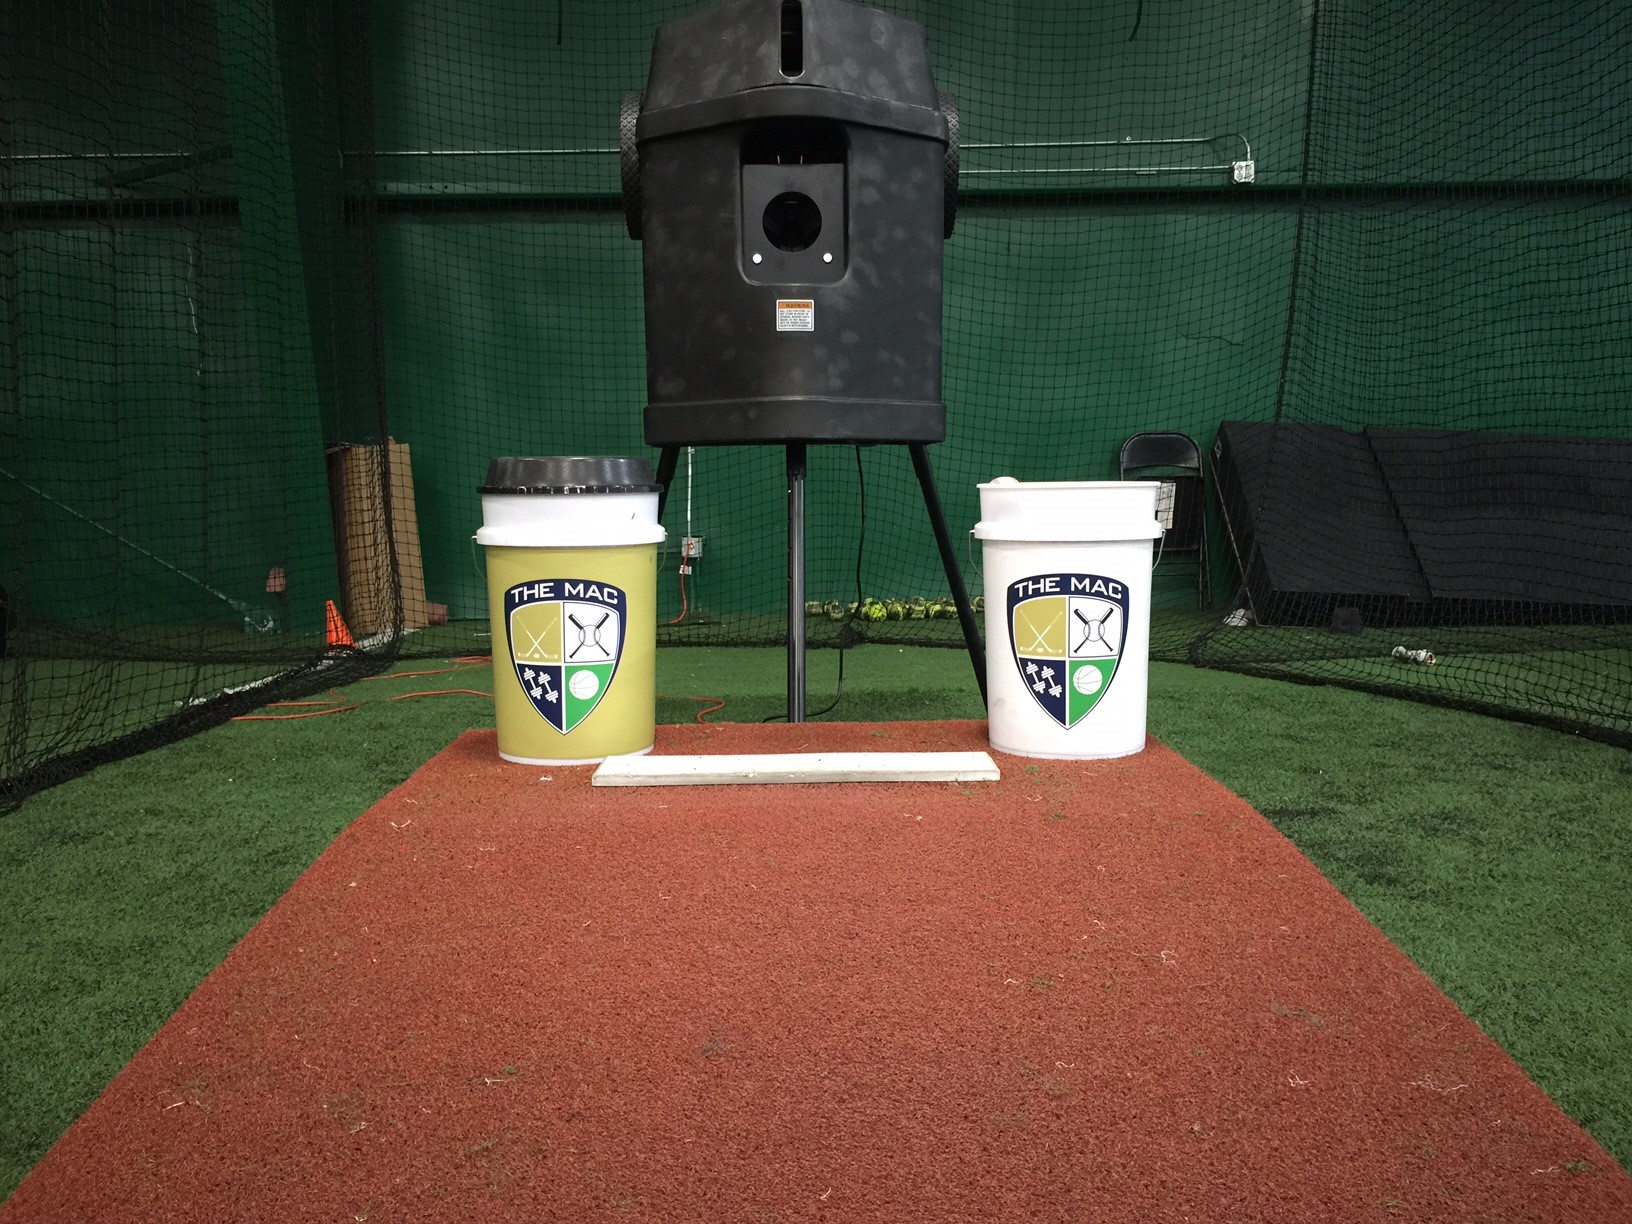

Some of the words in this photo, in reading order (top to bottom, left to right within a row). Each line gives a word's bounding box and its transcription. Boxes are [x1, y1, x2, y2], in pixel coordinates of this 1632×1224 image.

[510, 582, 555, 604] THE
[564, 582, 618, 605] MAC
[1014, 577, 1061, 598] THE
[1070, 577, 1122, 600] MAC
